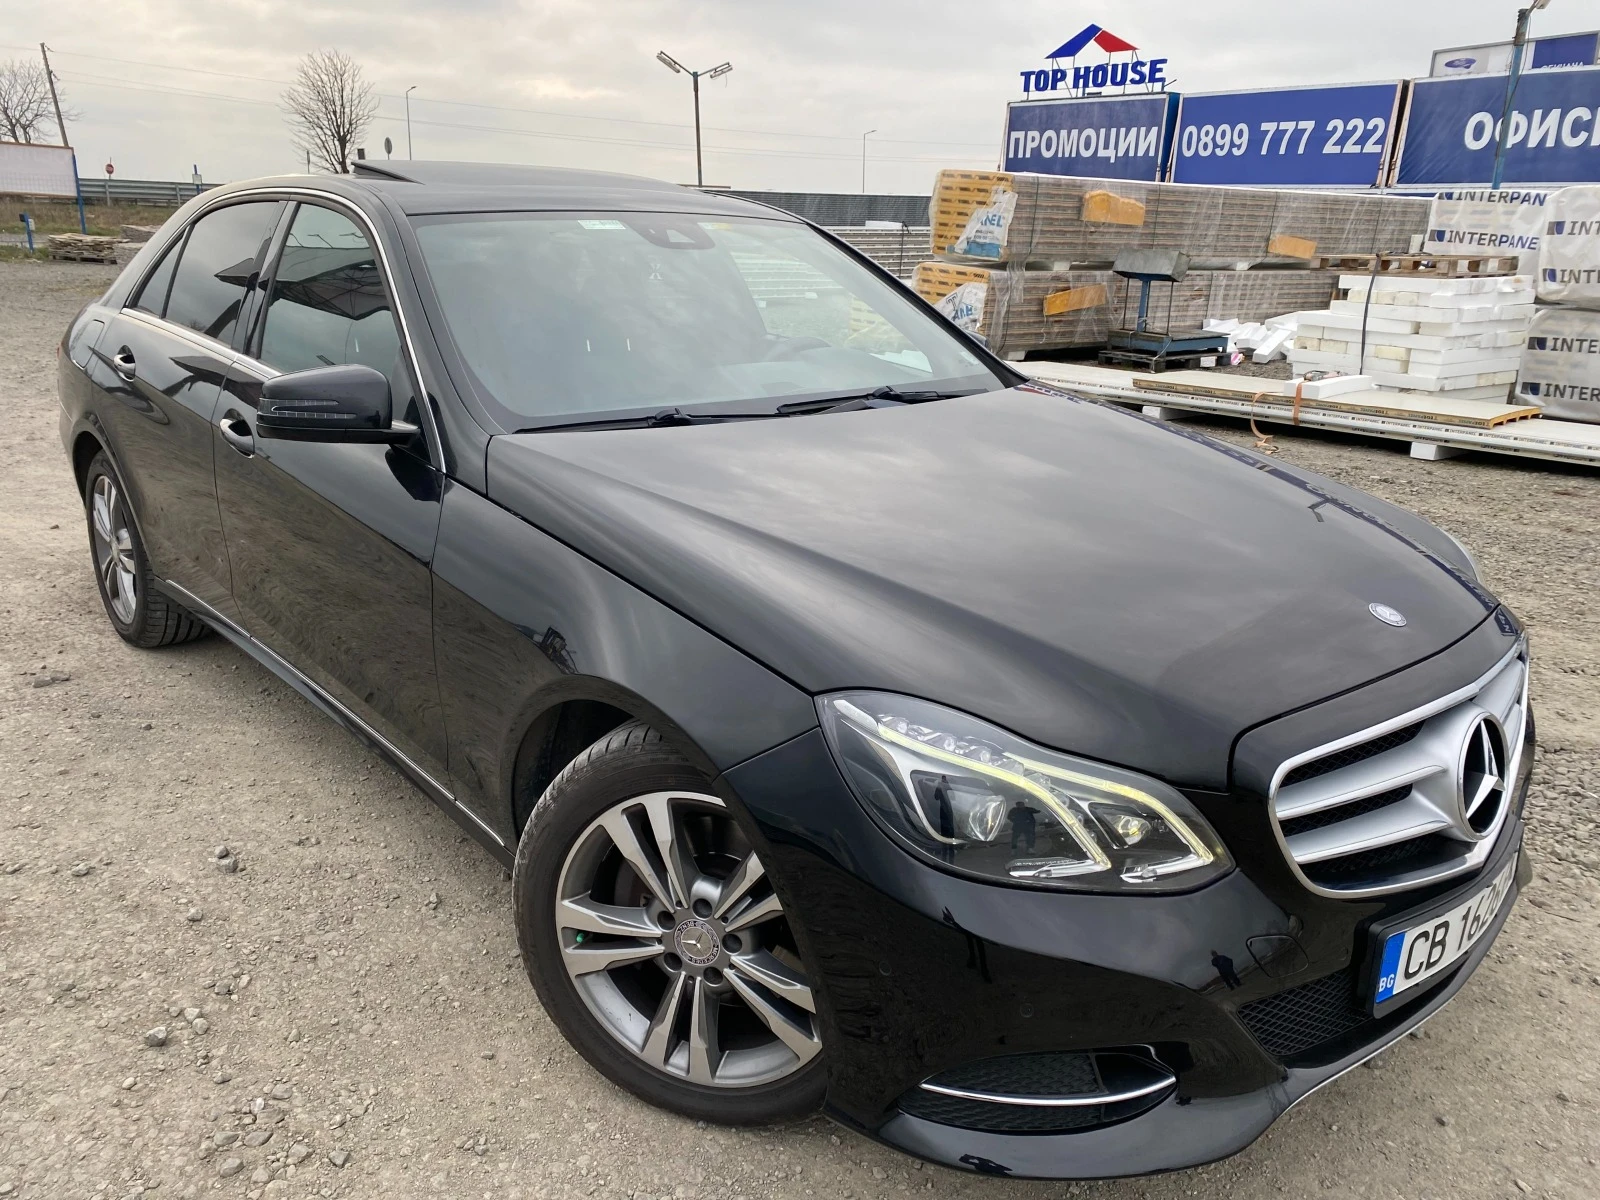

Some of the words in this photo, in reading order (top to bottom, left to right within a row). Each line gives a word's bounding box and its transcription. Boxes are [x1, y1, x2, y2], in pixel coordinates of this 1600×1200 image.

[1020, 69, 1067, 92] TOP
[1072, 58, 1168, 89] HOUSE
[1008, 126, 1159, 163] ПРОМОЦИИ
[1181, 123, 1249, 157] 0899
[1260, 120, 1315, 155] 777
[1322, 117, 1386, 154] 222
[1550, 337, 1600, 354] INTE
[1543, 383, 1600, 402] INTER
[1379, 974, 1395, 992] BG
